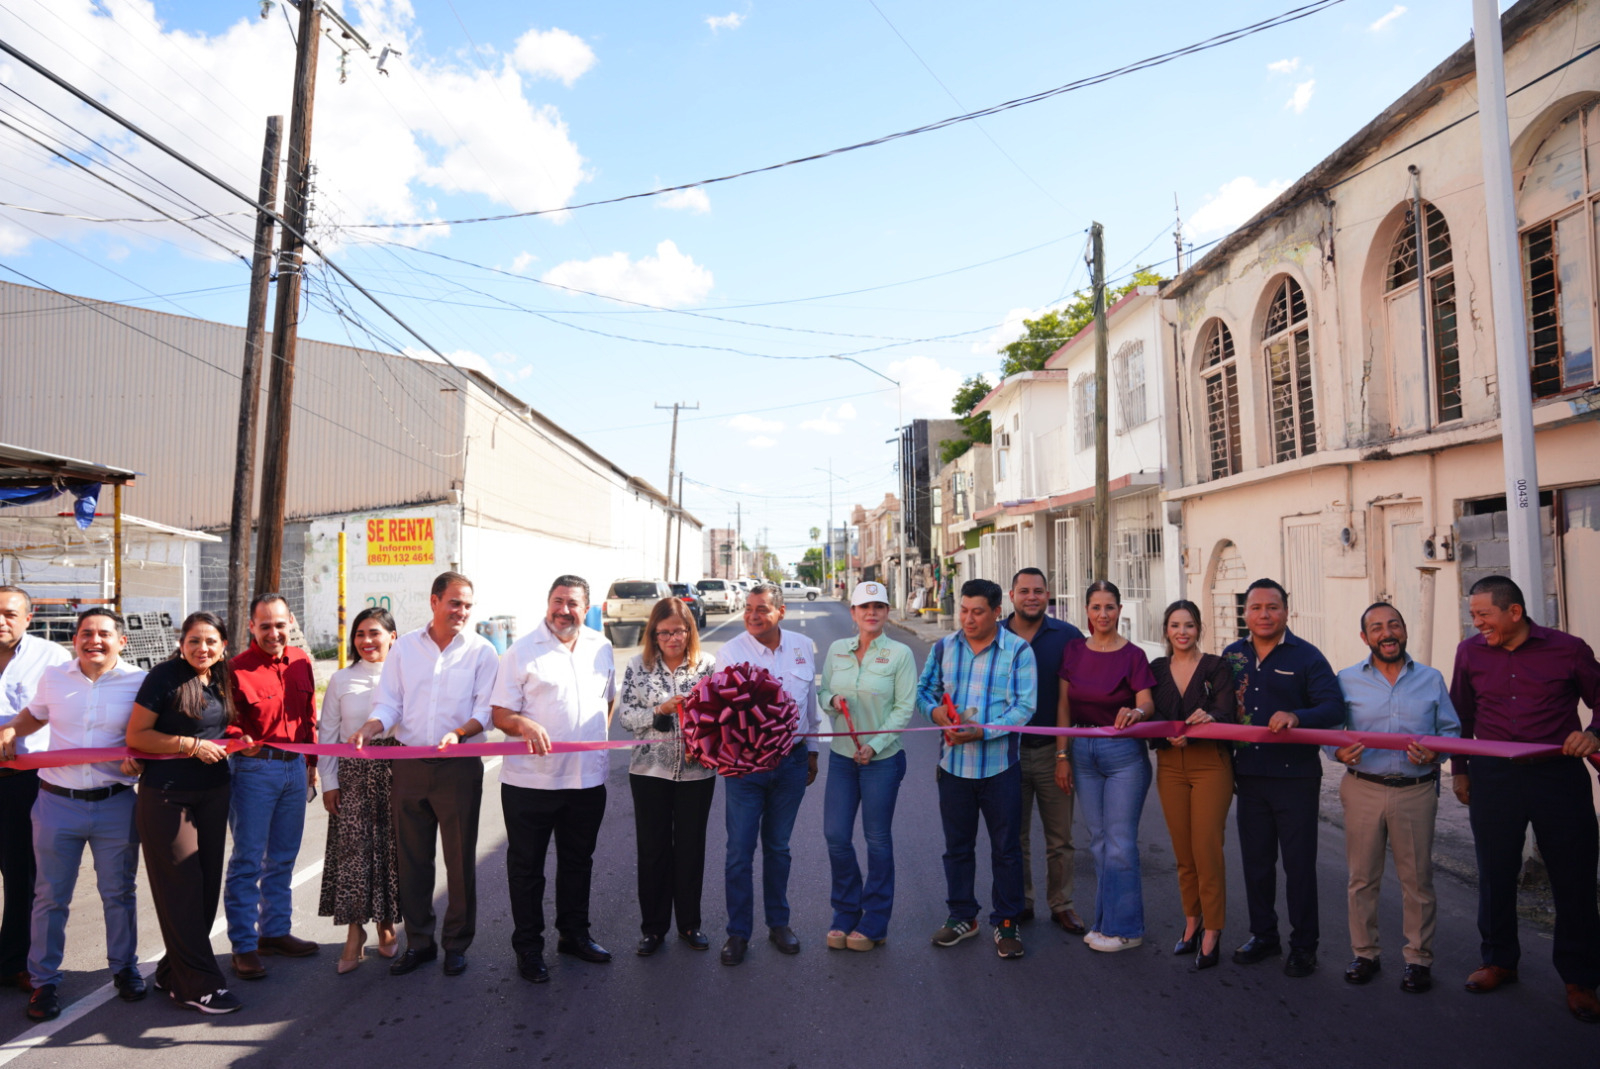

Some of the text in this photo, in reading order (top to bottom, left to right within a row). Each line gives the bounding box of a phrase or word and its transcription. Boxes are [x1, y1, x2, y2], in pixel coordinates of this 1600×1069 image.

[1517, 479, 1528, 508] 00438
[367, 518, 434, 542] SE RENTA
[379, 544, 423, 552] Informes
[368, 552, 434, 565] (867) 132 4614
